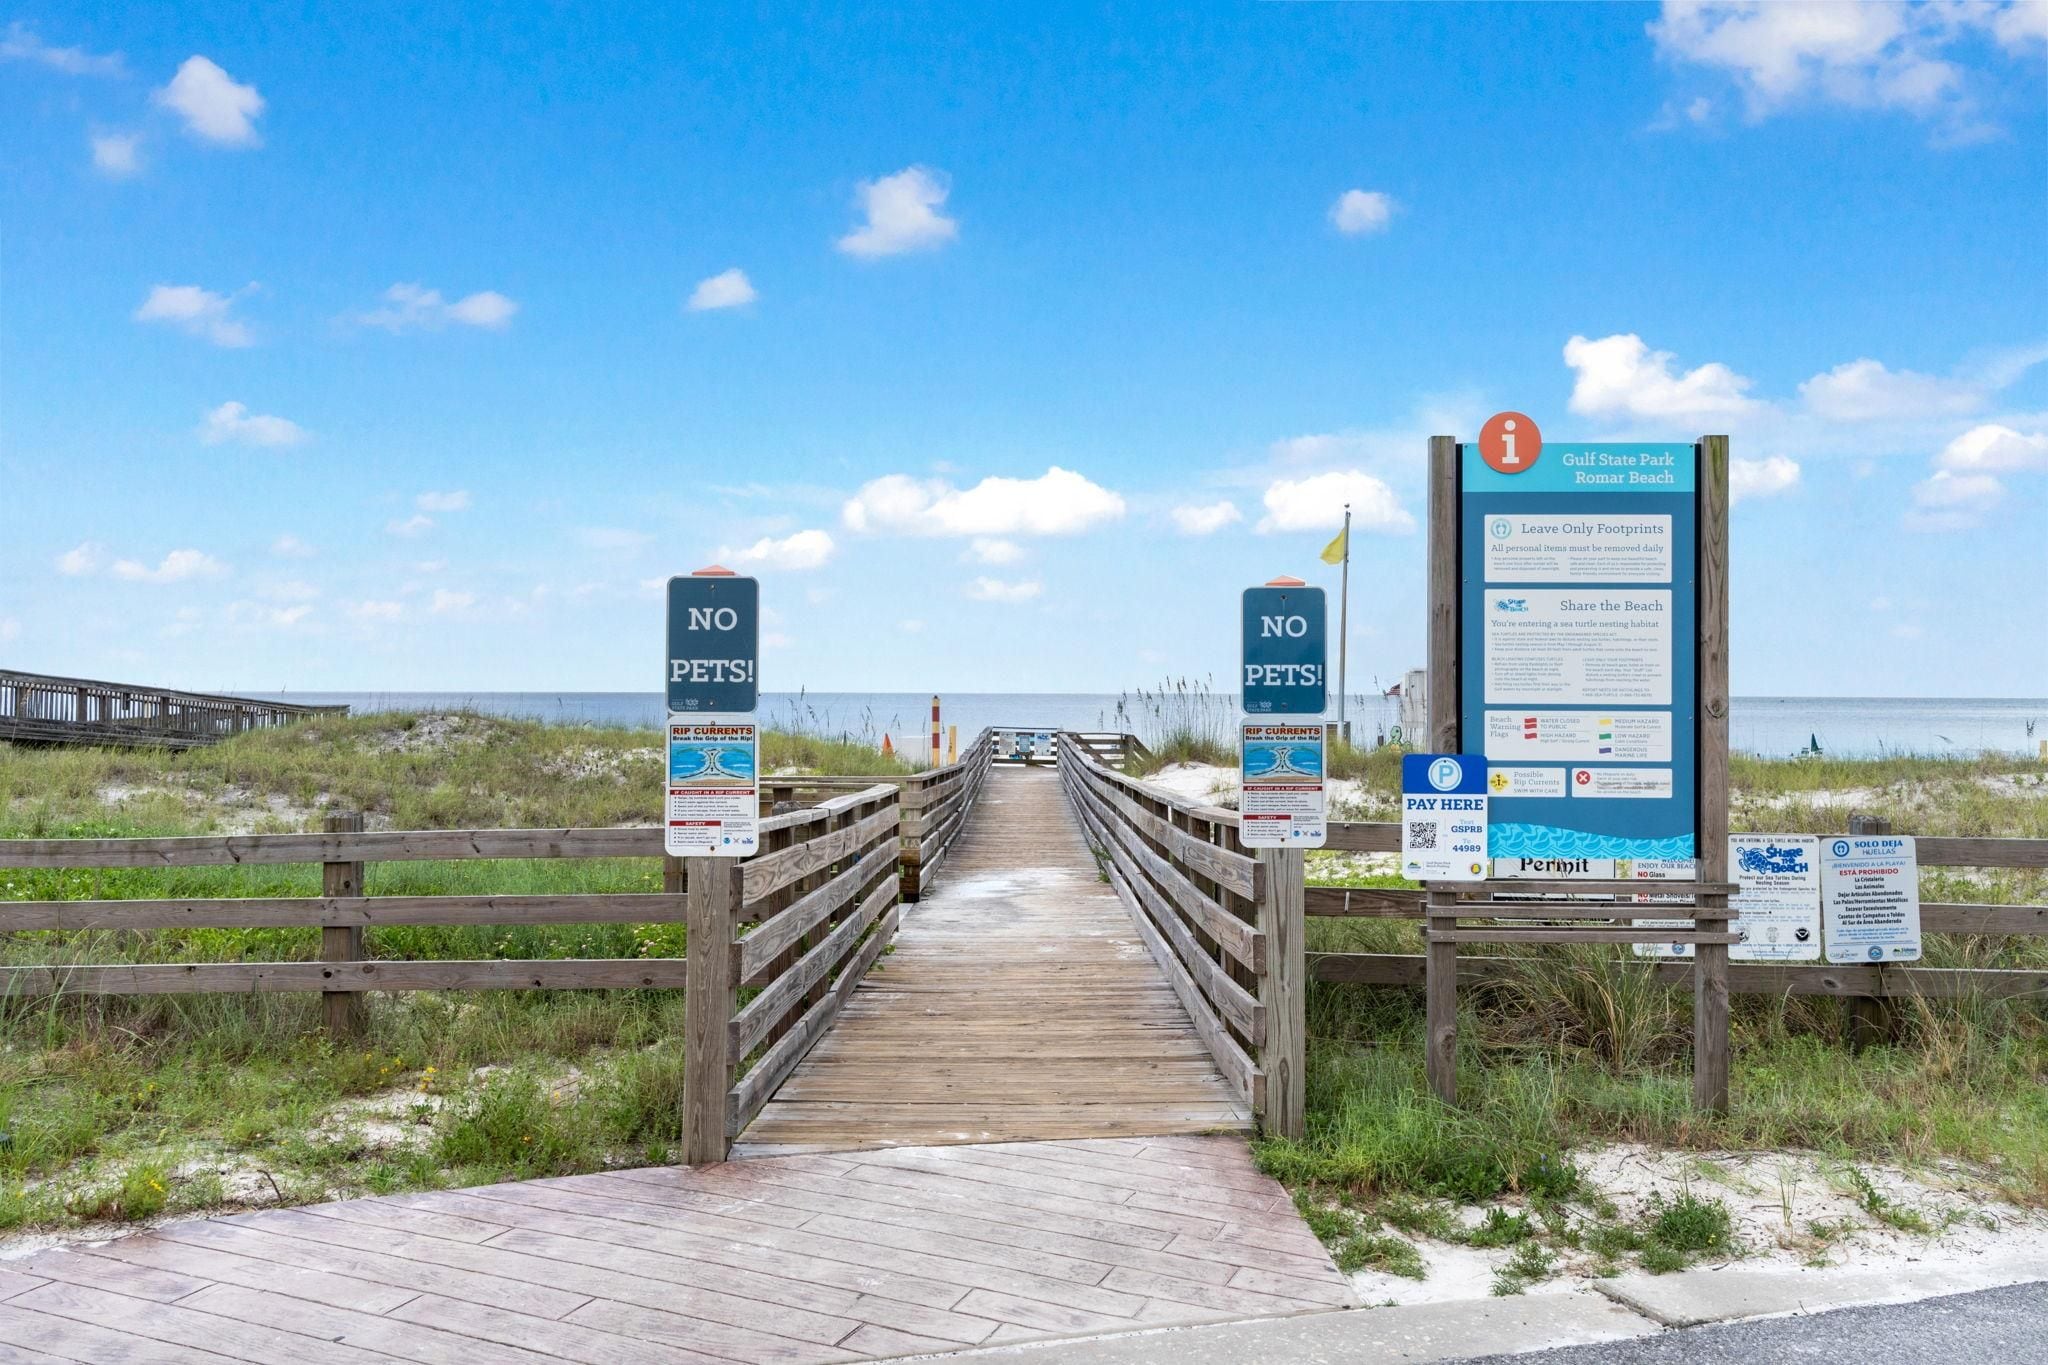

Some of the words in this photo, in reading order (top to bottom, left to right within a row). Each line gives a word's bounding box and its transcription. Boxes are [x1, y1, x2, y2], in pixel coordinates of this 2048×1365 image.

[1563, 453, 1595, 467] Gulf
[1599, 453, 1637, 467] State
[1640, 453, 1675, 467] Park
[1575, 472, 1625, 484] Romar
[1629, 471, 1674, 484] Beach
[1521, 523, 1559, 535] Leave
[1562, 522, 1594, 537] Only
[1597, 523, 1664, 537] Footprints
[1491, 544, 1504, 552] All
[1506, 544, 1542, 554] personal
[1544, 544, 1566, 552] items
[1569, 544, 1590, 552] must
[1592, 544, 1602, 552] be
[1604, 544, 1640, 552] removed
[1643, 544, 1664, 554] daily
[1560, 600, 1597, 612] Share
[1600, 600, 1621, 612] the
[1624, 600, 1663, 612] Beach
[688, 608, 738, 631] NO
[1491, 620, 1515, 628] You're
[1518, 620, 1552, 630] entering
[1575, 620, 1597, 628] turtle
[1599, 620, 1629, 630] nesting
[1631, 620, 1659, 628] habitat
[1261, 616, 1307, 637] NO
[670, 659, 754, 683] PETS!
[1245, 664, 1323, 686] PETS!
[673, 727, 690, 735] RIP
[694, 727, 752, 735] CURRENTS
[1490, 723, 1521, 732] Warning
[1514, 779, 1528, 787] Rip
[1407, 798, 1438, 810] PAY
[1441, 798, 1484, 810] HERE
[1451, 825, 1483, 833] GSPRB
[1452, 844, 1481, 852] 44989
[1882, 840, 1903, 848] DEJA
[1863, 848, 1896, 856] HUELLAS
[1520, 858, 1589, 875] Permit
